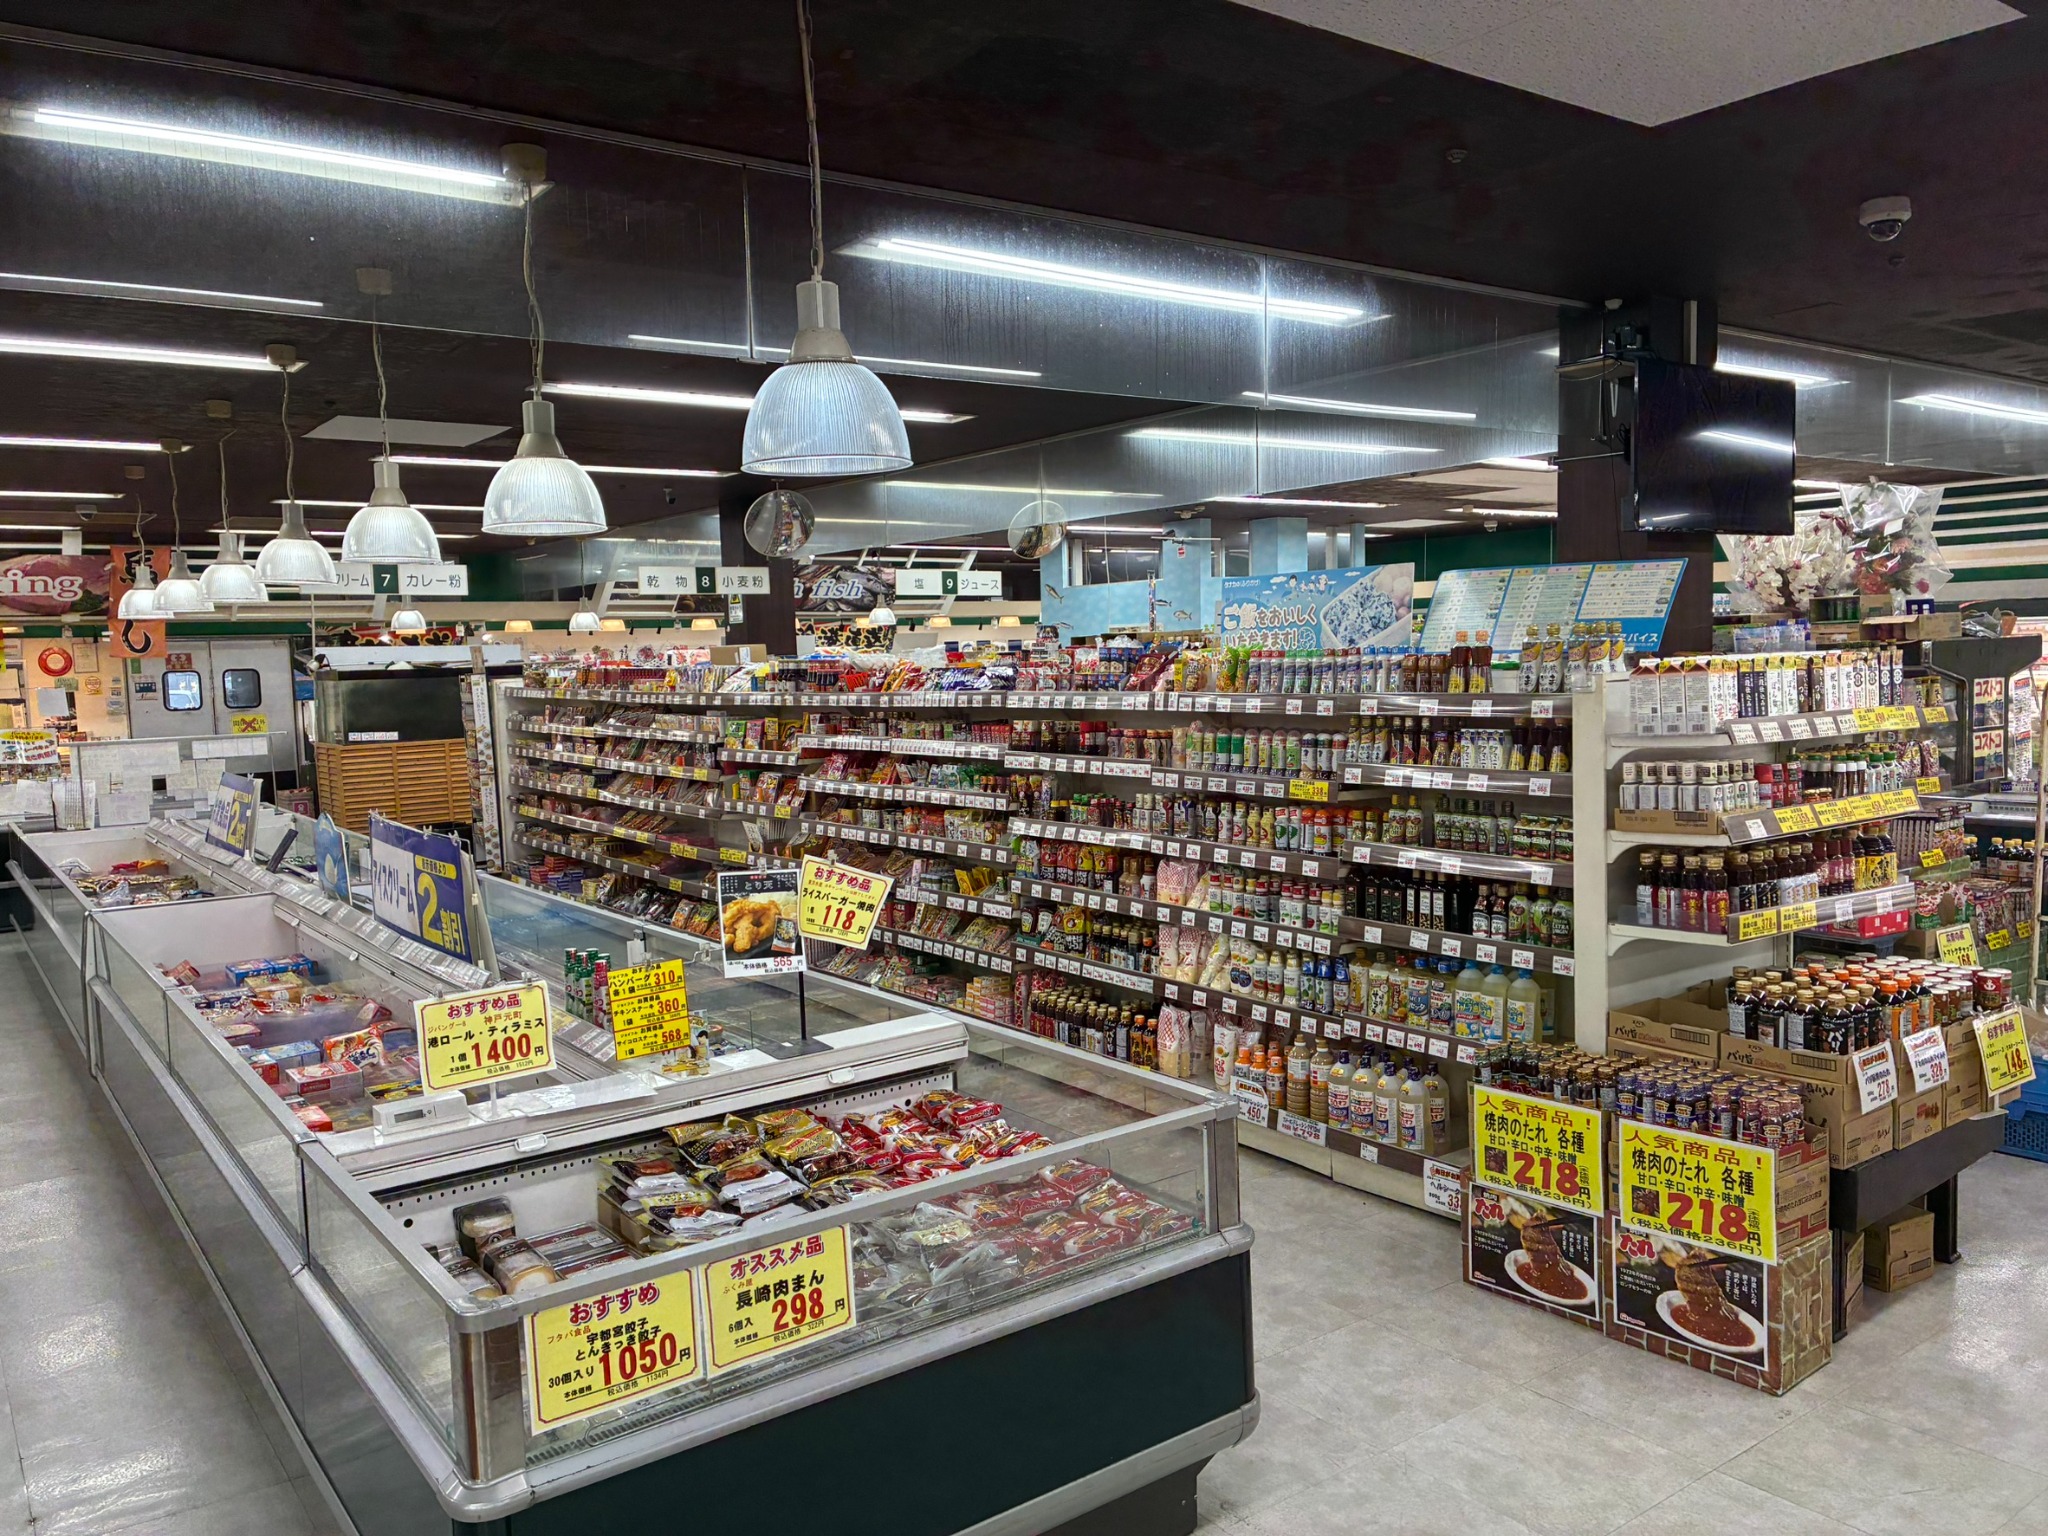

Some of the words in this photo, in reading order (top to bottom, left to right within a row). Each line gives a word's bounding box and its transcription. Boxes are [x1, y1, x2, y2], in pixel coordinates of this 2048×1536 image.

[0, 570, 83, 601] ing
[380, 574, 391, 586] 7
[406, 574, 461, 588] カレー粉
[702, 575, 710, 587] 8
[722, 575, 764, 588] 小麦粉
[812, 578, 864, 600] fish
[914, 578, 925, 590] 塩
[946, 579, 953, 588] 9
[961, 578, 999, 590] ジュース
[1223, 602, 1318, 631] ご飯をおいしく
[1975, 680, 2003, 698] コストコ
[1974, 733, 2002, 751] コストコ
[420, 856, 449, 876] 表示価格より
[744, 880, 774, 890] とり天
[814, 866, 873, 893] おすすめ品
[373, 858, 416, 916] アイスクリーム
[418, 872, 444, 946] 2
[440, 907, 467, 956] 割引
[802, 887, 876, 914] ライスバーガー焼肉
[822, 904, 857, 931] 118
[857, 925, 867, 935] 円
[743, 962, 768, 970] 本体価格
[773, 956, 793, 967] 565
[797, 959, 804, 967] 円
[1943, 944, 1973, 957] トマトケチャップ
[610, 974, 651, 989] ハンバーグ
[654, 970, 676, 986] 310
[448, 993, 522, 1019] おすすめ品
[484, 1011, 522, 1026] 神戸元町
[613, 1004, 655, 1017] チキンステーキ
[657, 998, 680, 1015] 360
[427, 1017, 545, 1049] 港ロール・ティラミス
[617, 1033, 658, 1047] サイコロステーキ
[661, 1028, 682, 1043] 568
[1986, 1019, 2015, 1040] おすすめ品
[450, 1053, 467, 1064] 1個
[471, 1033, 532, 1068] 1400
[534, 1046, 545, 1056] 円
[2004, 1047, 2022, 1074] 148
[487, 1065, 511, 1075] 税込価格
[1930, 1062, 1943, 1079] 328
[1877, 1079, 1891, 1098] 278
[1246, 1105, 1261, 1120] 450
[1479, 1095, 1573, 1128] 人気商品
[1484, 1110, 1548, 1143] 焼肉のたれ
[1557, 1127, 1585, 1154] 各種
[1625, 1129, 1740, 1167] 人気商品
[1513, 1151, 1580, 1196] 218
[1578, 1186, 1591, 1200] 円
[1632, 1146, 1709, 1184] 焼肉のたれ
[1721, 1166, 1755, 1196] 各種
[1447, 1194, 1461, 1209] 33
[1474, 1197, 1506, 1222] たれ
[1667, 1192, 1748, 1242] 218
[1747, 1231, 1762, 1247] 円
[730, 1234, 826, 1280] オススメ品
[1618, 1232, 1657, 1260] たれ
[735, 1269, 826, 1312] 長崎肉まん
[568, 1281, 662, 1326] おすすめ
[728, 1317, 754, 1334] 6個入
[771, 1287, 825, 1332] 298
[834, 1299, 846, 1312] 円
[546, 1325, 592, 1345] フタバ食品
[586, 1316, 650, 1345] 宇都宮餃子
[734, 1332, 759, 1347] 本体価格
[773, 1329, 801, 1343] 税込価格
[807, 1319, 826, 1332] 322円
[575, 1325, 662, 1362] とんきっき餃子
[548, 1366, 595, 1389] 30個入り
[598, 1331, 678, 1388] 1050
[679, 1347, 692, 1361] 円
[564, 1384, 592, 1399] 本体価格
[607, 1380, 639, 1397] 税込価格
[646, 1369, 670, 1383] 1134円
